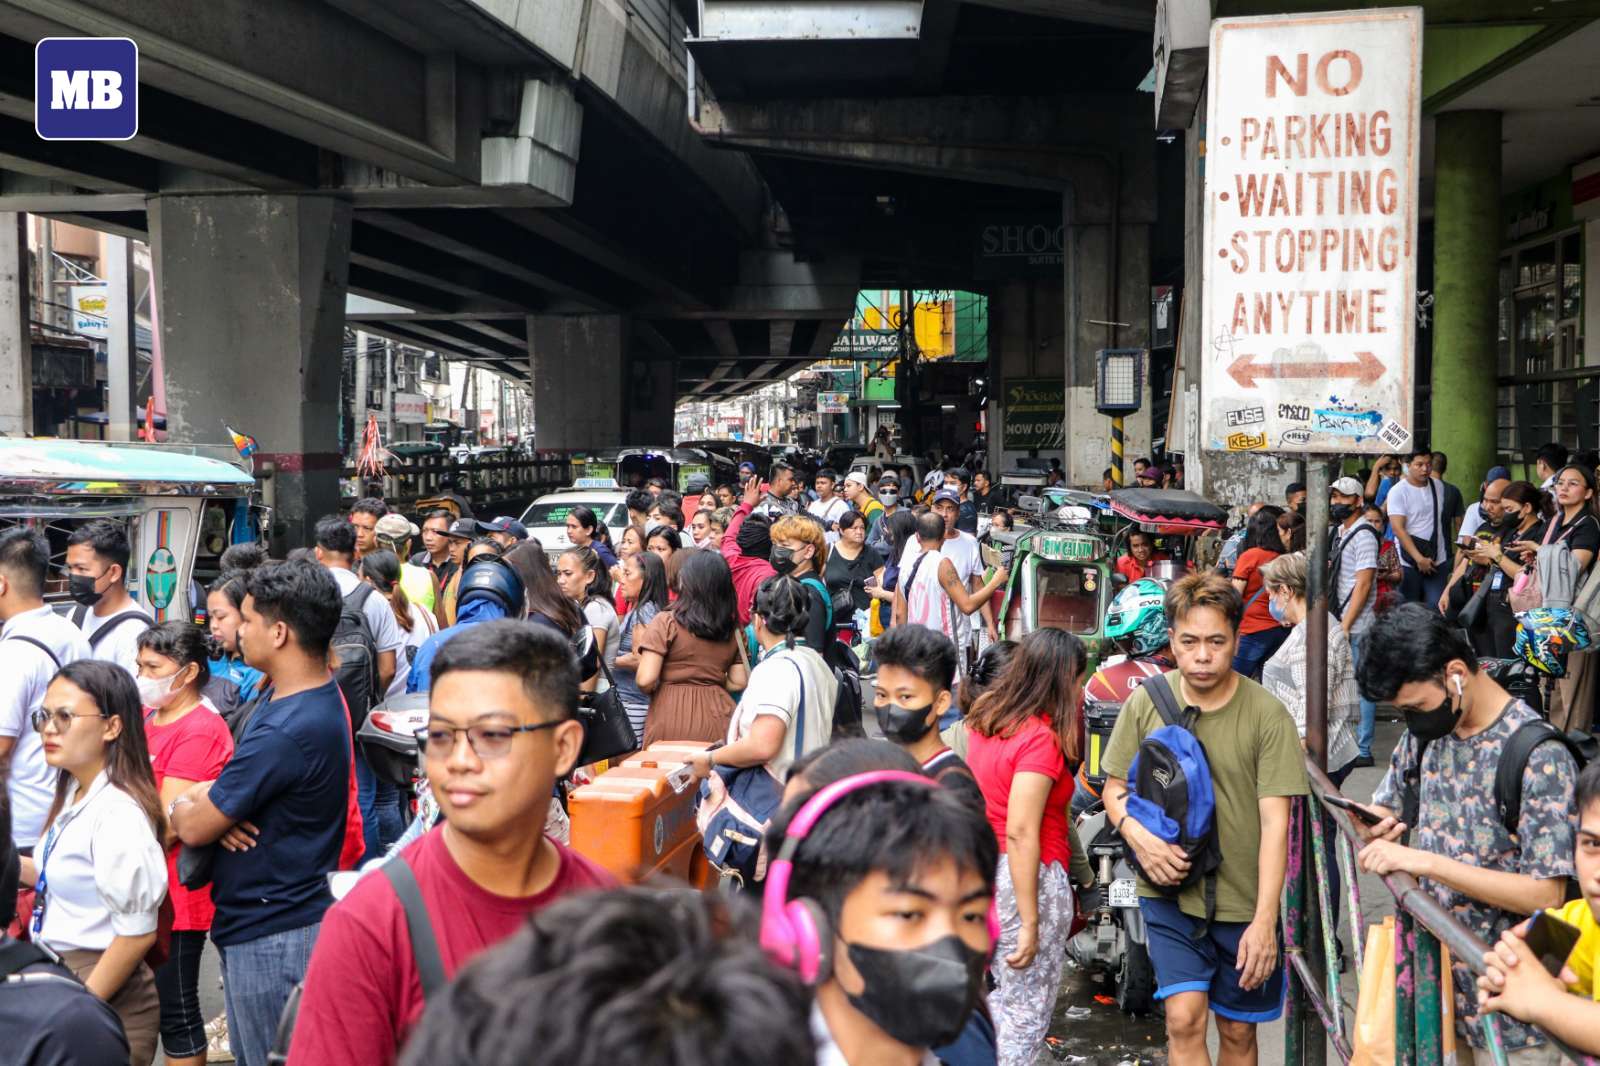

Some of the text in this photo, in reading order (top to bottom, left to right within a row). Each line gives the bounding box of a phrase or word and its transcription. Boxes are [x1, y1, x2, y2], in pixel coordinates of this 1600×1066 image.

[1266, 50, 1363, 97] NO
[1240, 110, 1392, 160] PARKING
[1235, 169, 1398, 217] WAITING
[1230, 228, 1398, 274] STOPPING
[1230, 289, 1388, 335] ANYTIME
[1006, 423, 1033, 434] NOW
[1227, 408, 1264, 426] FUSE
